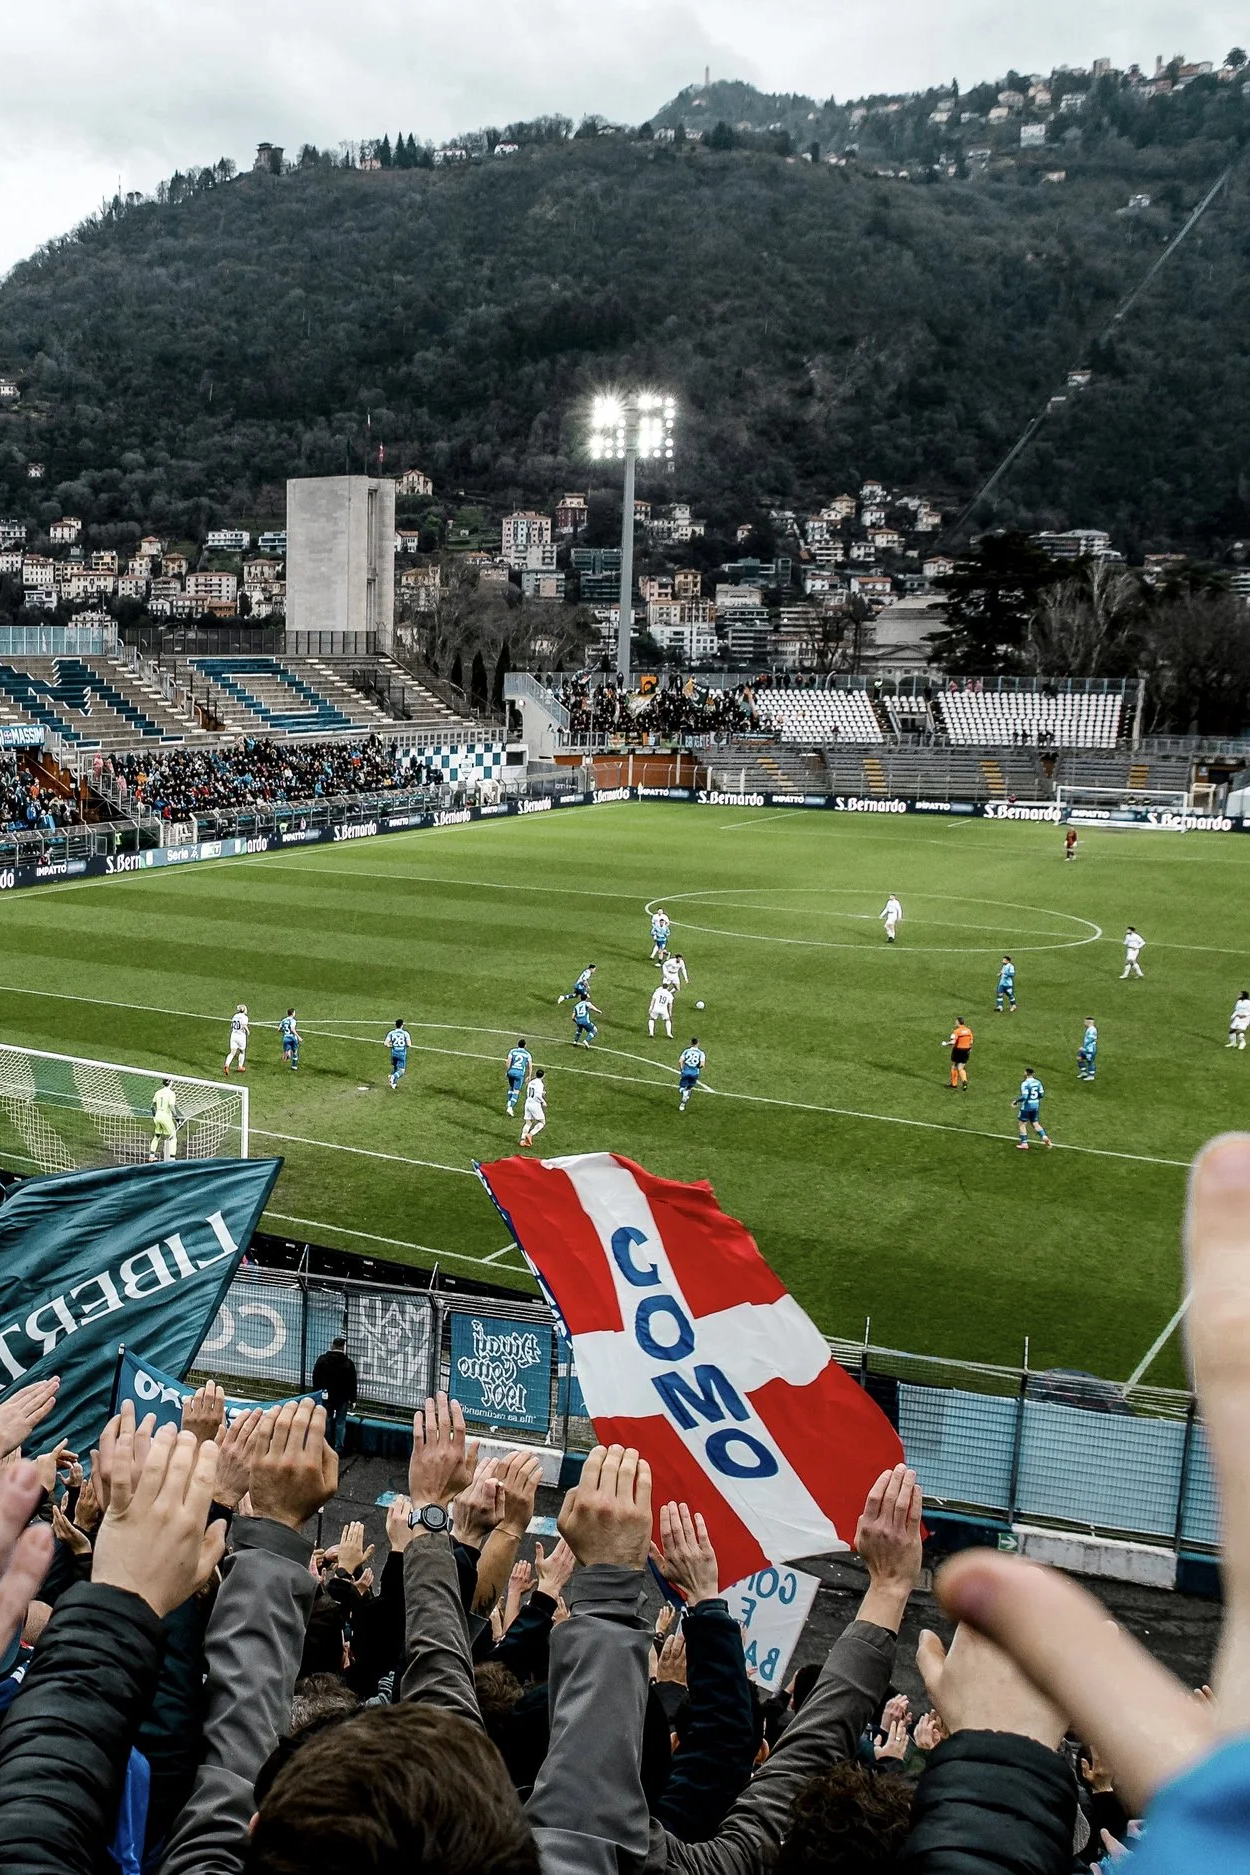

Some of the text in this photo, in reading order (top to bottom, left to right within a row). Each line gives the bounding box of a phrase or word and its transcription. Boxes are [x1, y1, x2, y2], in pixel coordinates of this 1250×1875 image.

[697, 790, 764, 807] S.Bernardo
[834, 796, 907, 813] S.Bernardo
[983, 804, 1062, 821] S.Bernardo
[610, 1226, 780, 1480] COMO
